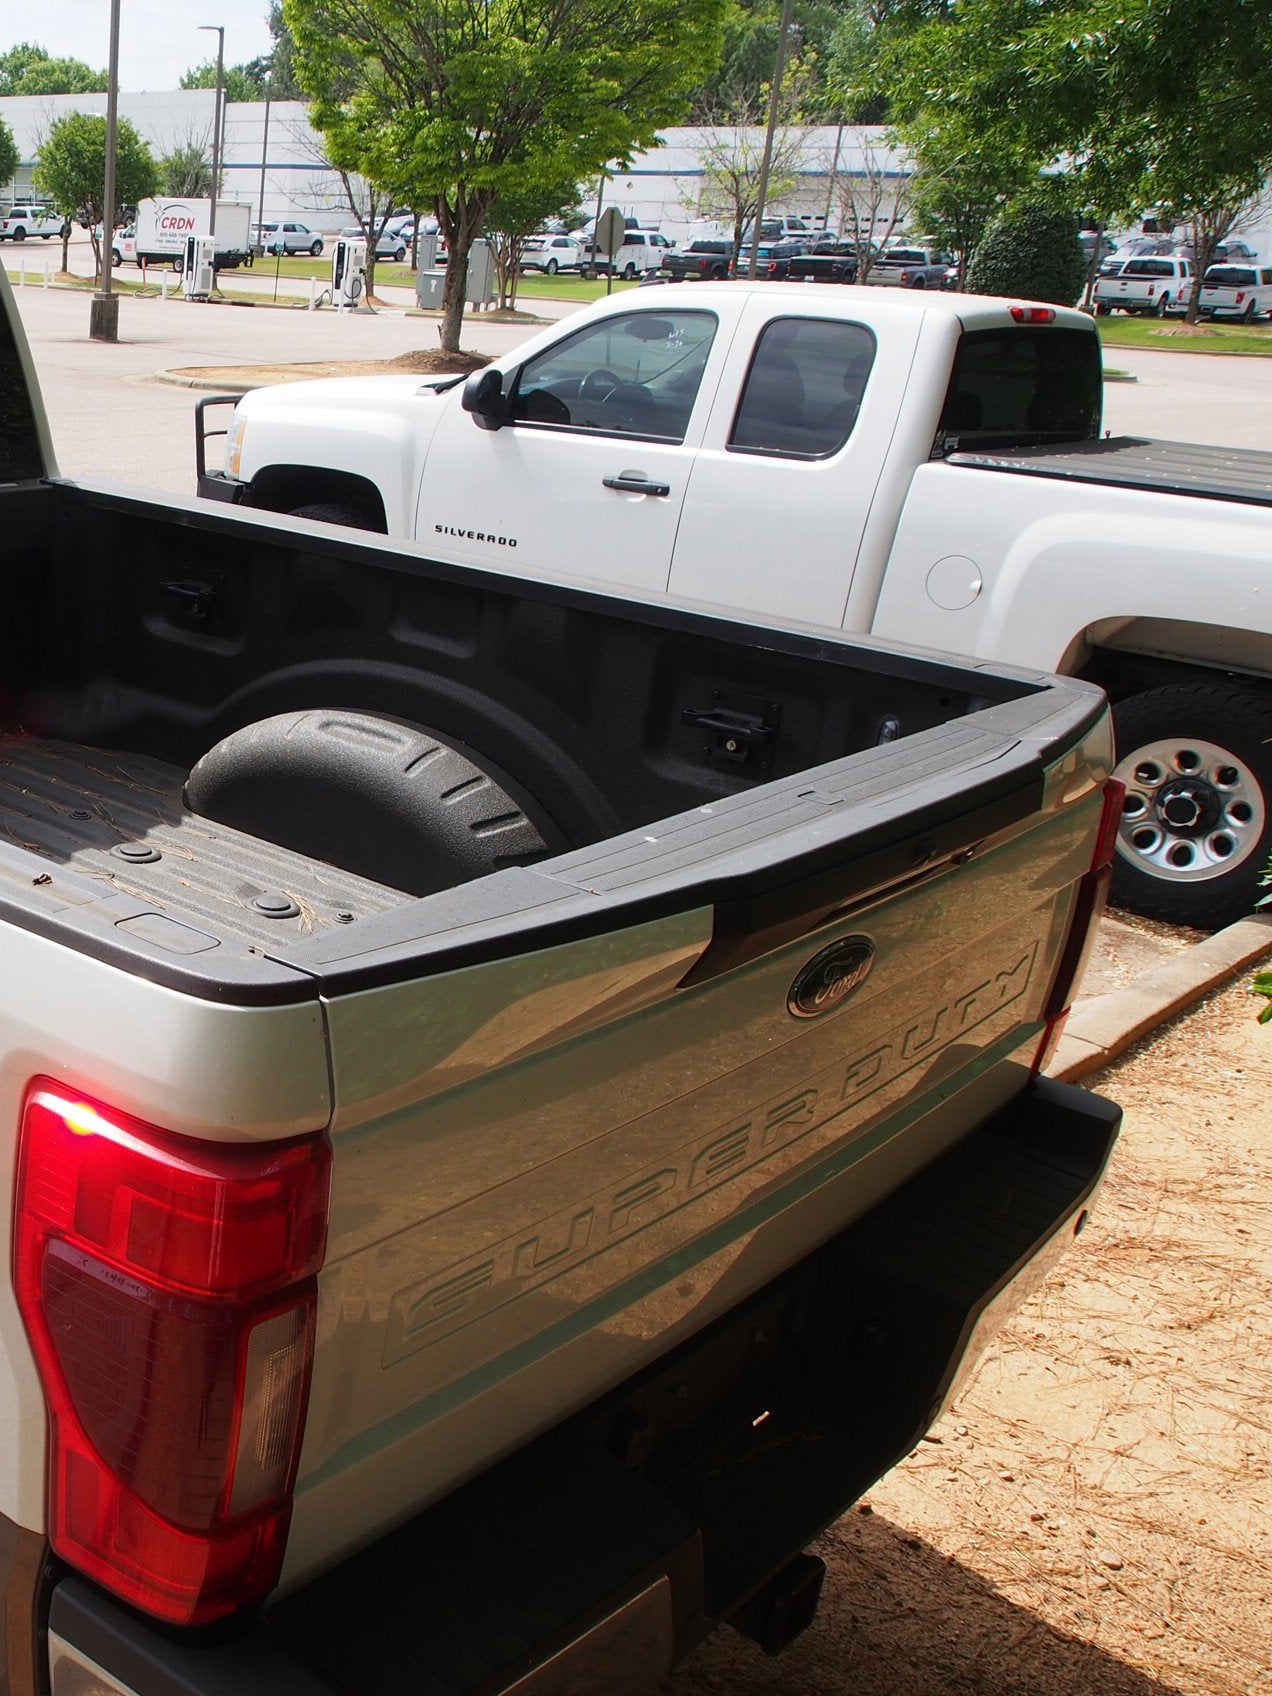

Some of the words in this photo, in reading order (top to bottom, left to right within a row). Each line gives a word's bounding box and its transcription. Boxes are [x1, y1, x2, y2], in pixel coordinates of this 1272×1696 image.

[161, 217, 195, 230] CRDN
[435, 525, 517, 547] SILVERADO
[814, 957, 863, 1004] Ford
[401, 1088, 820, 1343] SUPER
[840, 953, 1030, 1101] DUTY
